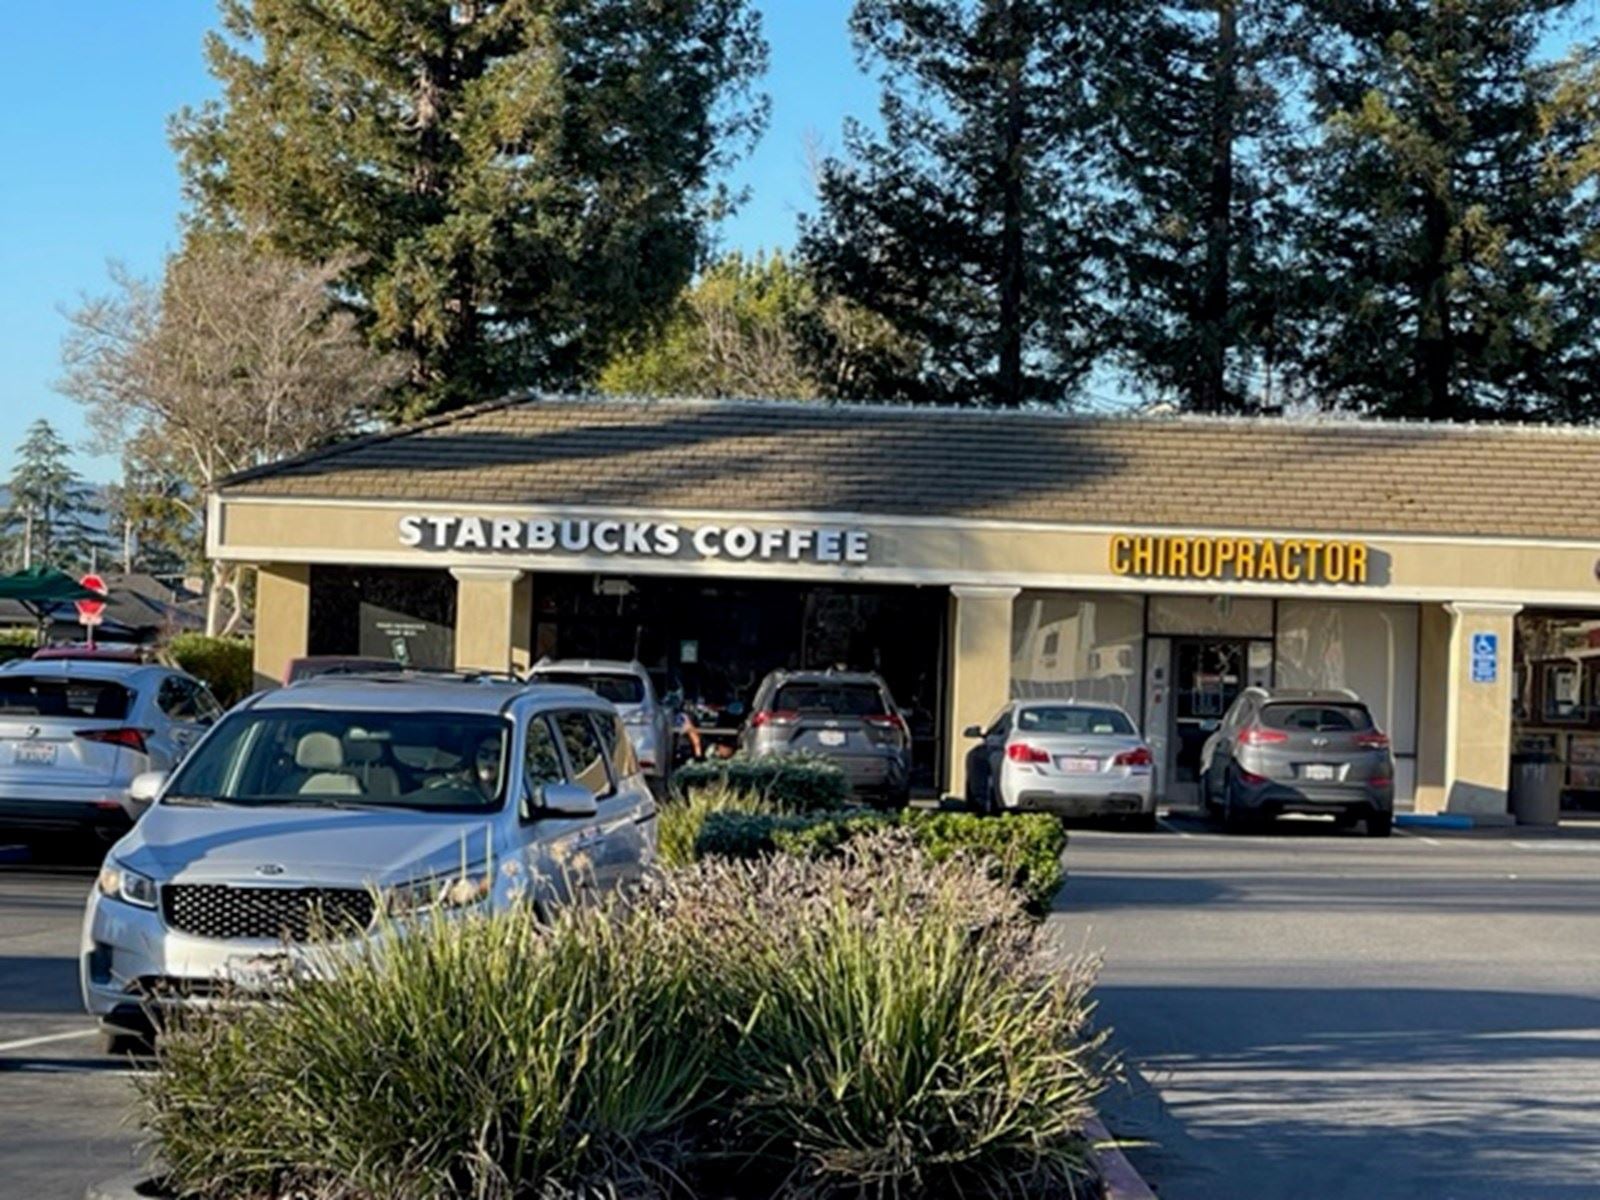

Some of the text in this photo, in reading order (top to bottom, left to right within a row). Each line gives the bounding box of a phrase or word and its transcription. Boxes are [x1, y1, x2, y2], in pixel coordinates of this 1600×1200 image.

[398, 515, 869, 563] STARBUCKS COFFEE
[1109, 533, 1368, 583] CHIROPRACTOR
